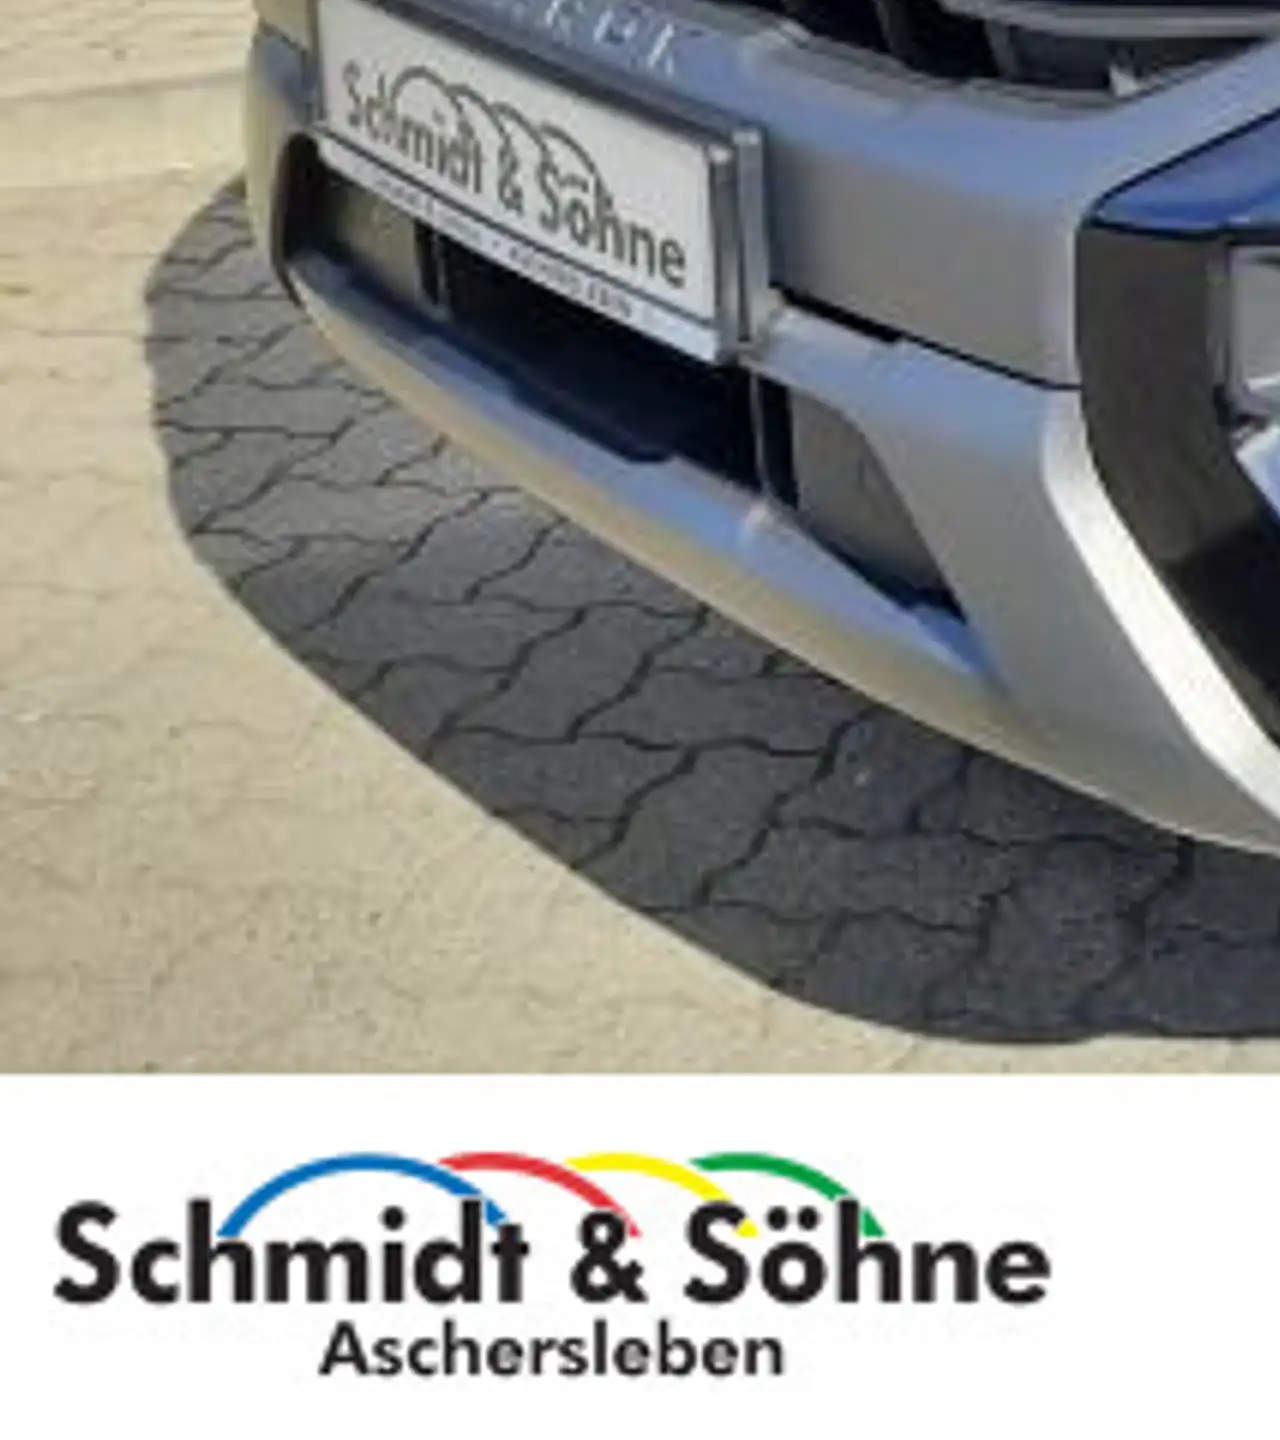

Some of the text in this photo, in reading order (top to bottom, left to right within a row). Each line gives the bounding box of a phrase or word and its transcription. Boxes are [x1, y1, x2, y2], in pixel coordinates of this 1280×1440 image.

[341, 58, 484, 196] Schmidt
[498, 134, 524, 218] &
[537, 158, 688, 292] Söhne
